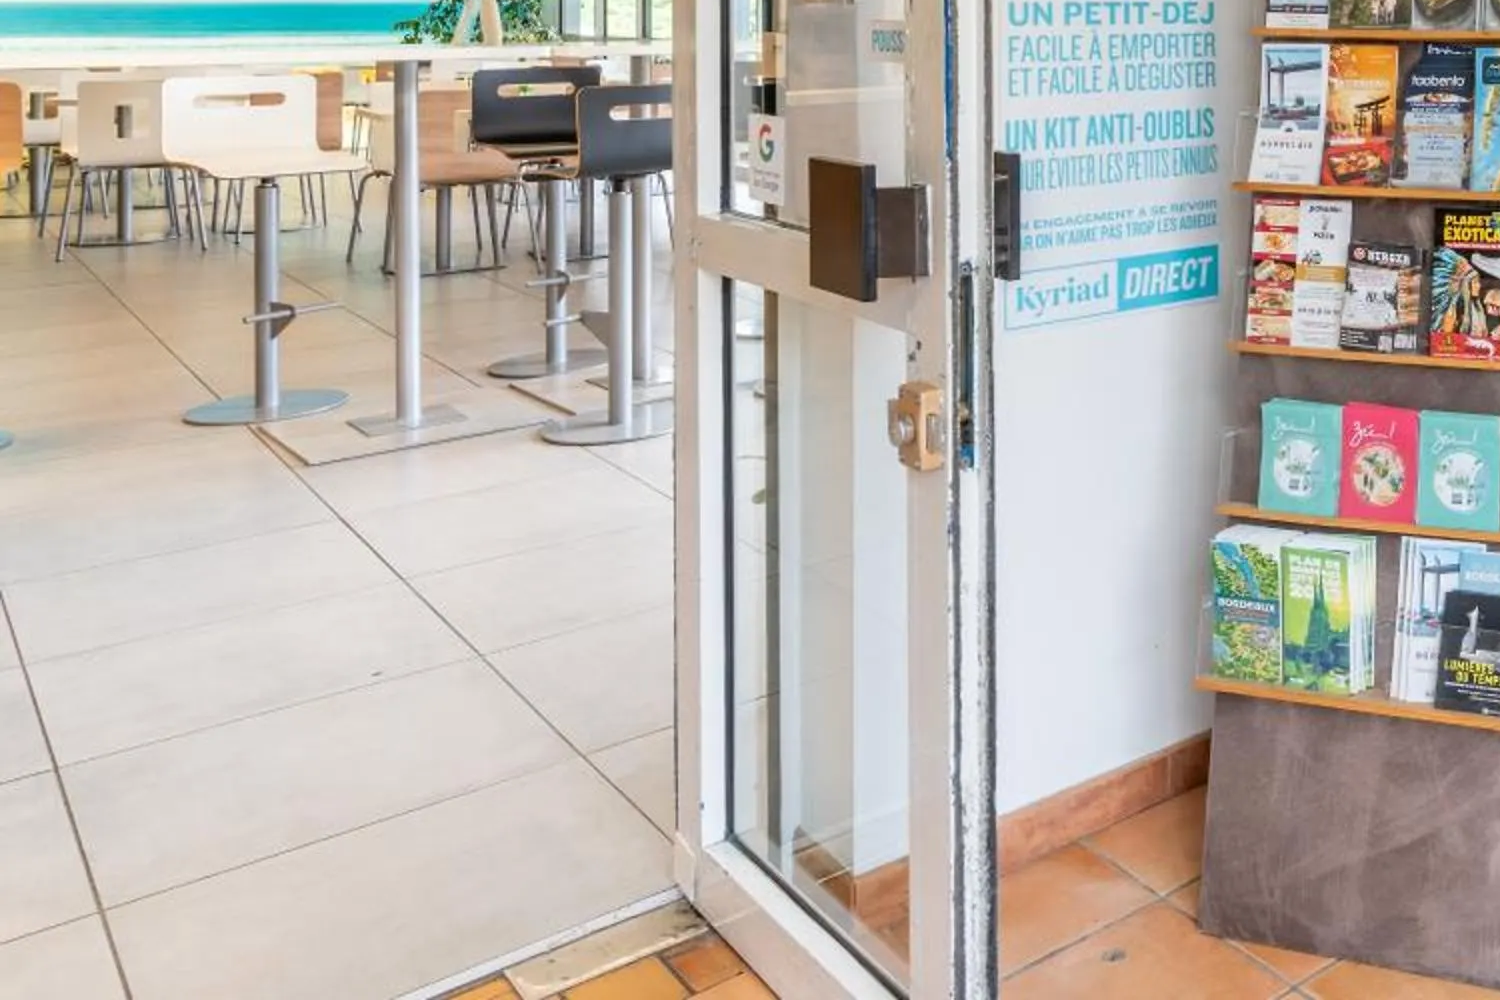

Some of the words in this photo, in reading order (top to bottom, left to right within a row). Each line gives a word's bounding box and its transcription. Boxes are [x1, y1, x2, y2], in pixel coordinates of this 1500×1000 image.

[1008, 1, 1053, 26] UN
[1008, 34, 1083, 63] FACILE
[1109, 32, 1216, 61] EMPORTER
[1008, 68, 1031, 97] ET
[1038, 65, 1103, 96] FACILE
[1006, 119, 1036, 151] UN
[1045, 115, 1080, 149] KIT
[1086, 107, 1215, 146] ANTI-OUBLIS
[1101, 151, 1123, 184] LES
[1126, 148, 1170, 182] PETITS
[1444, 215, 1491, 226] PLANET
[1015, 273, 1109, 317] Kyriad
[1124, 257, 1213, 300] DIRECT
